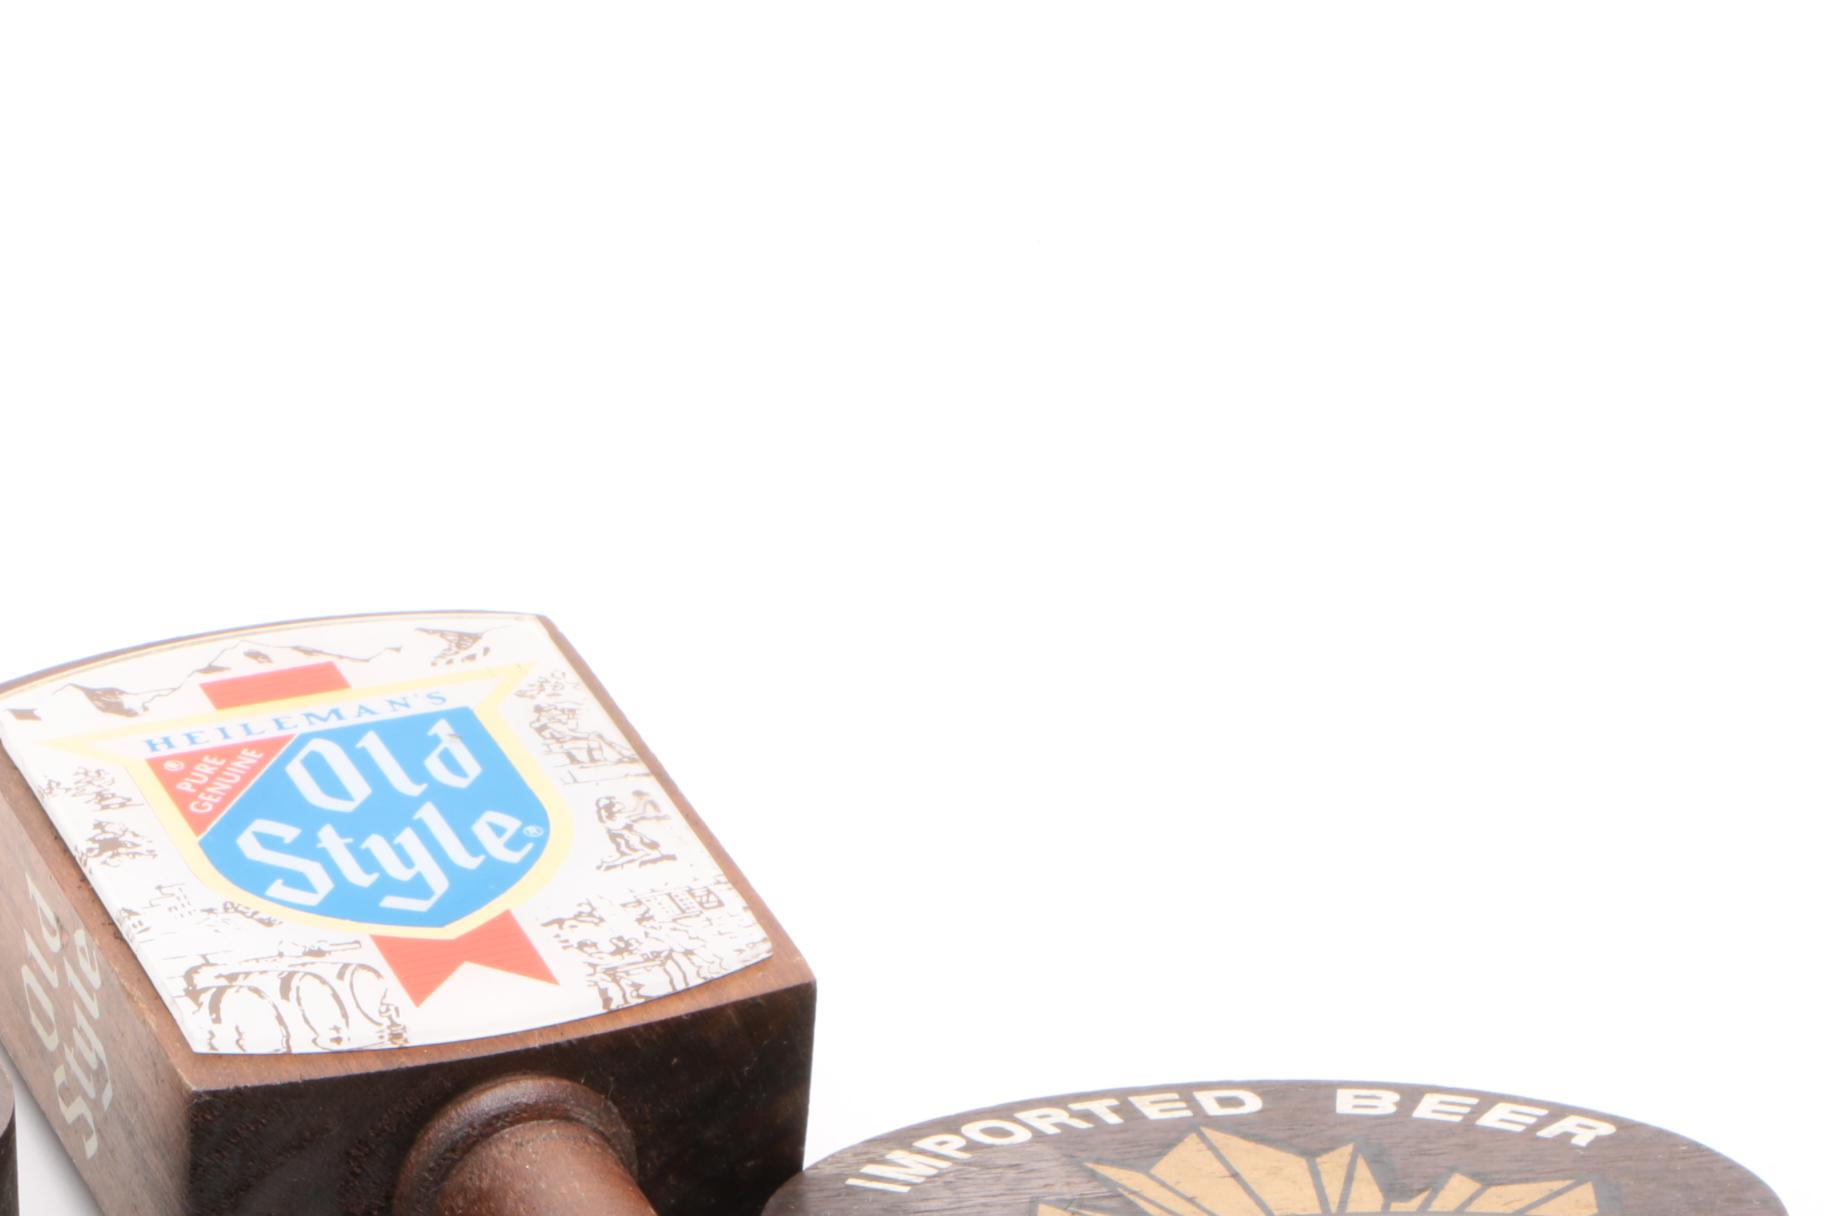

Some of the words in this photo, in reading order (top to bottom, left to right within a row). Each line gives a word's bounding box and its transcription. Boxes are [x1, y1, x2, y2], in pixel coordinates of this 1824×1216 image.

[143, 691, 448, 752] HEILEMAN'S
[285, 718, 482, 812] Old
[177, 754, 226, 793] PURE
[189, 748, 264, 814] GENUINE
[20, 872, 62, 1051] Old
[54, 929, 113, 1160] Style
[844, 1089, 1263, 1193] IMPORTED
[1335, 1088, 1616, 1150] BEER
